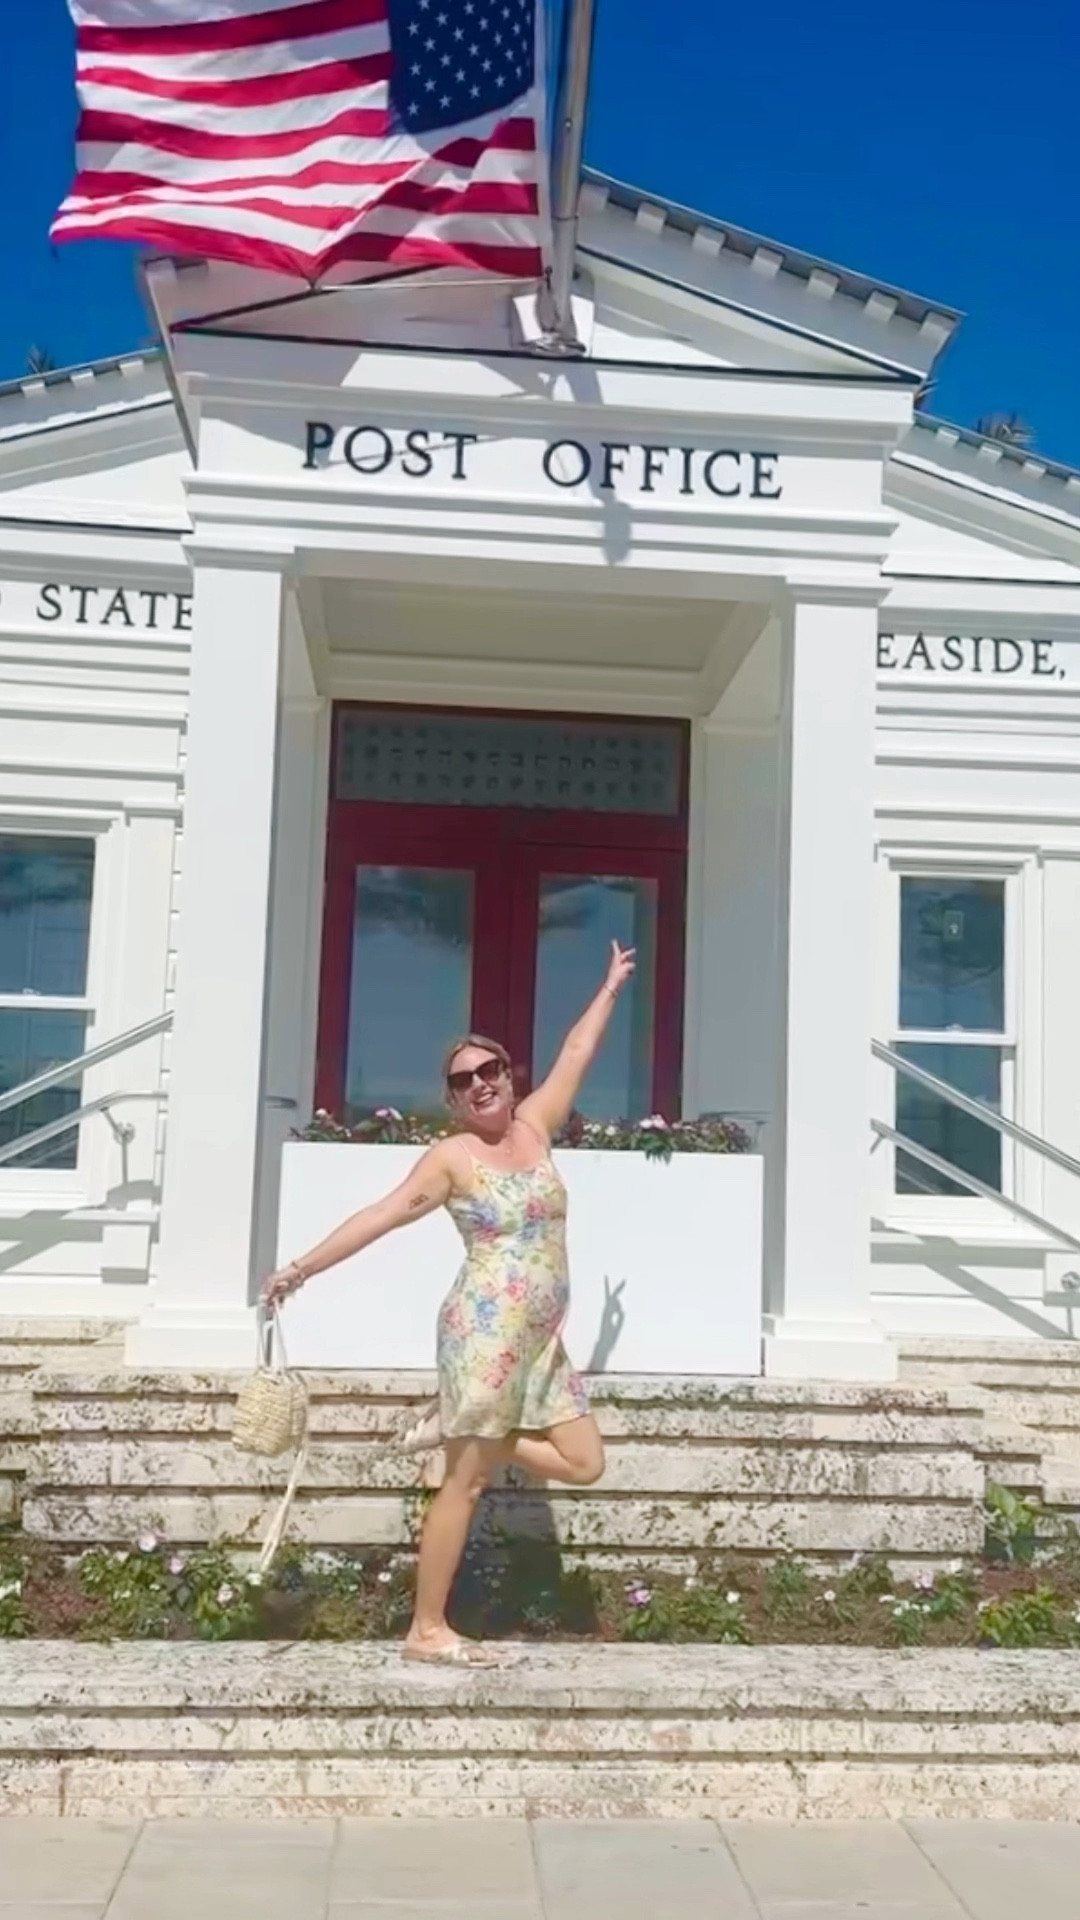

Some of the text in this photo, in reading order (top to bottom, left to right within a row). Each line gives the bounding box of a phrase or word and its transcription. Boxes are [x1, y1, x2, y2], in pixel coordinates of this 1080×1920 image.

[302, 422, 783, 499] POST OFFICE
[36, 583, 193, 630] STATE
[876, 631, 1066, 680] EASIDE,
